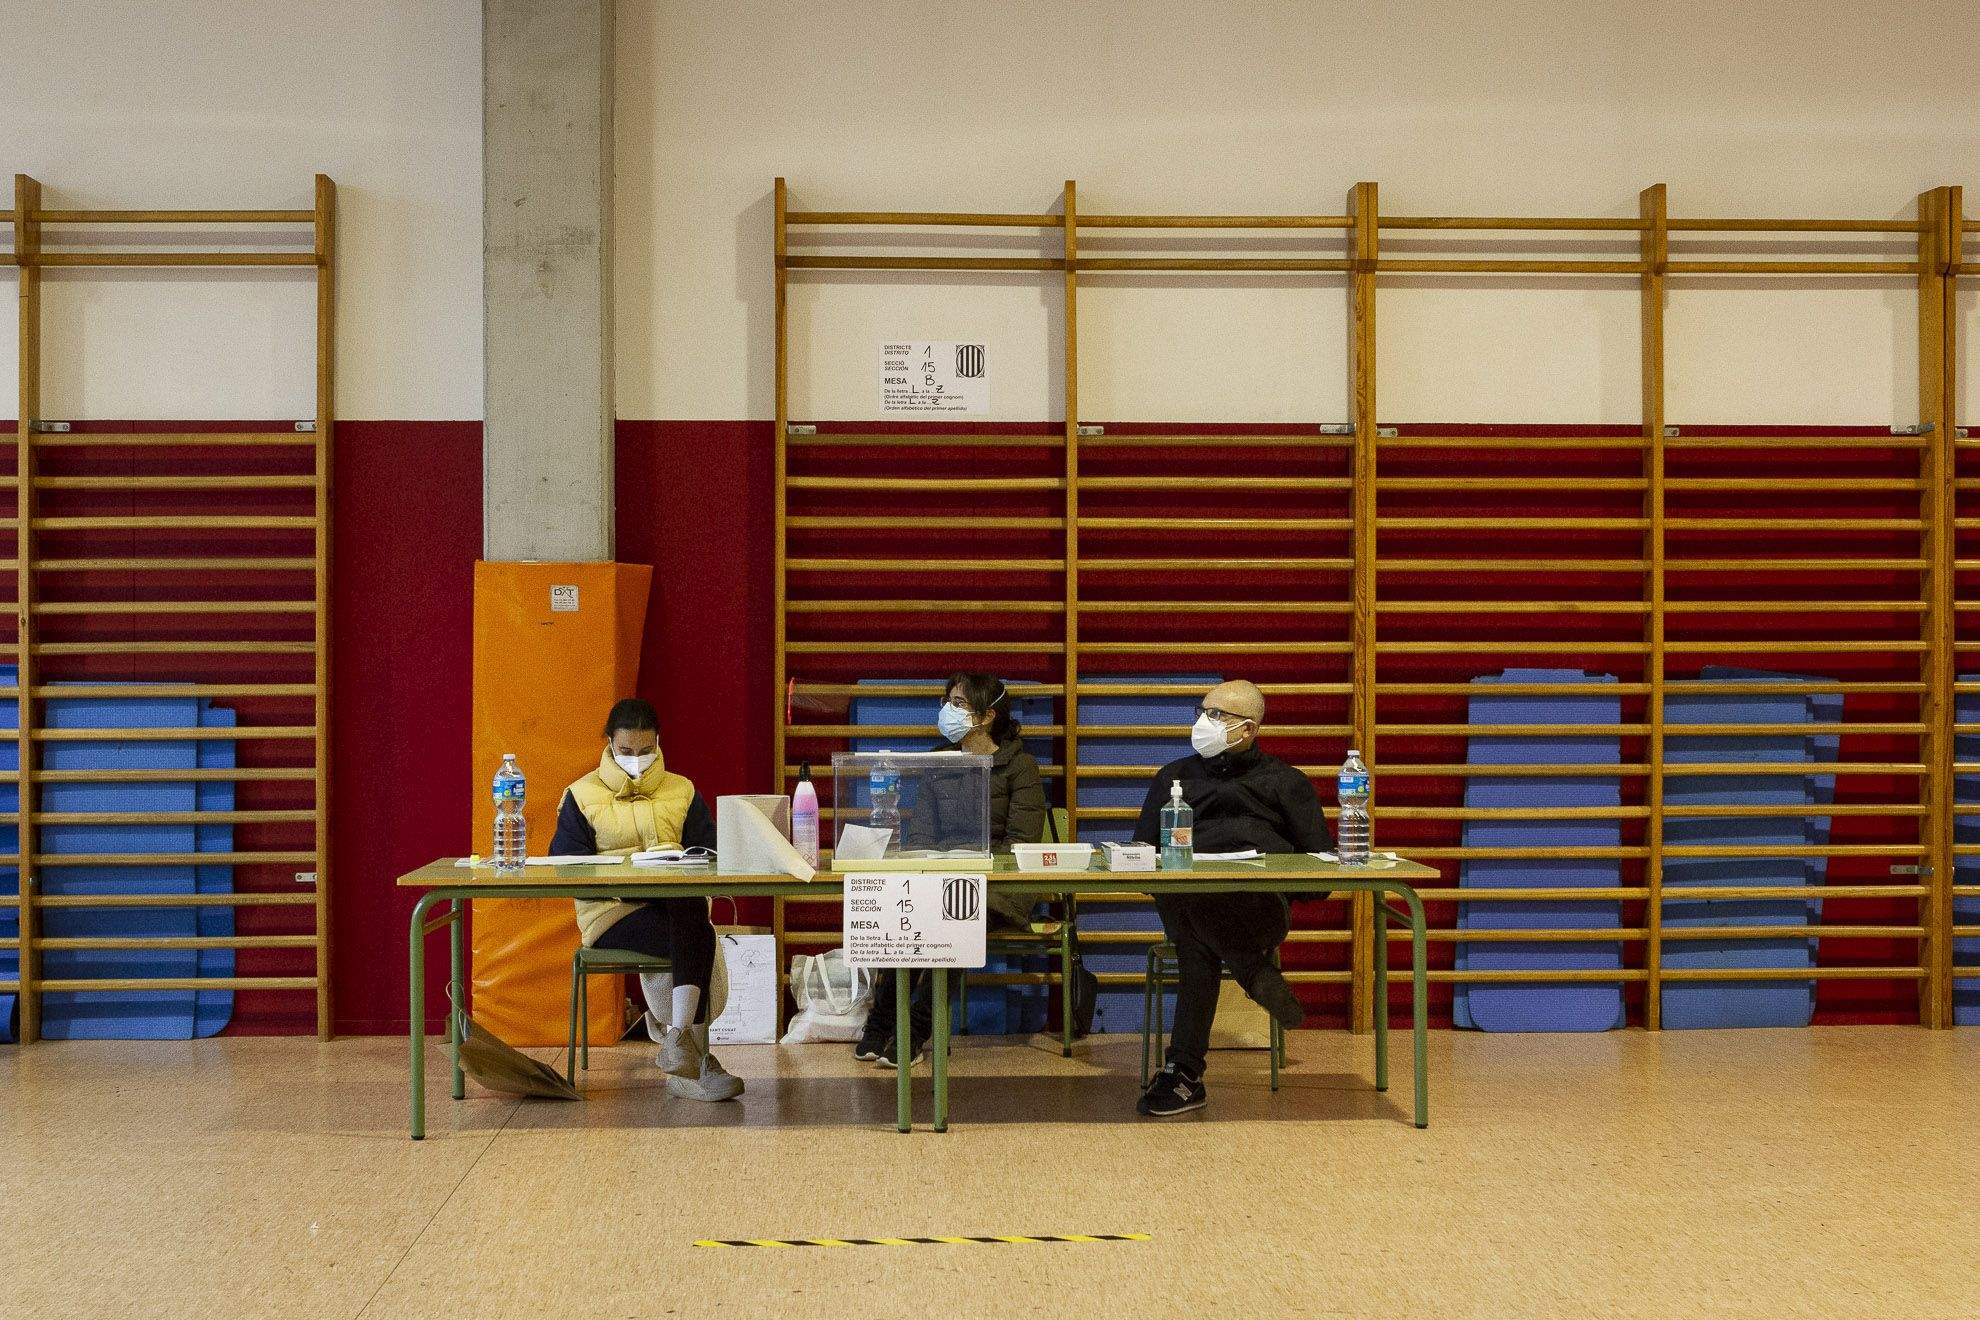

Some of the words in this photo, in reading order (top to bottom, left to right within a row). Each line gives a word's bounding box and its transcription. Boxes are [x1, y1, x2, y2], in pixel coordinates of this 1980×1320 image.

[923, 344, 931, 358] 1
[920, 362, 936, 372] 15
[925, 374, 936, 386] B
[912, 384, 920, 394] L
[902, 880, 910, 894] 1
[896, 899, 914, 913] 15
[850, 920, 880, 930] MESA
[900, 916, 912, 932] B
[885, 932, 892, 941] L
[914, 931, 922, 941] Z
[913, 946, 922, 955] Z
